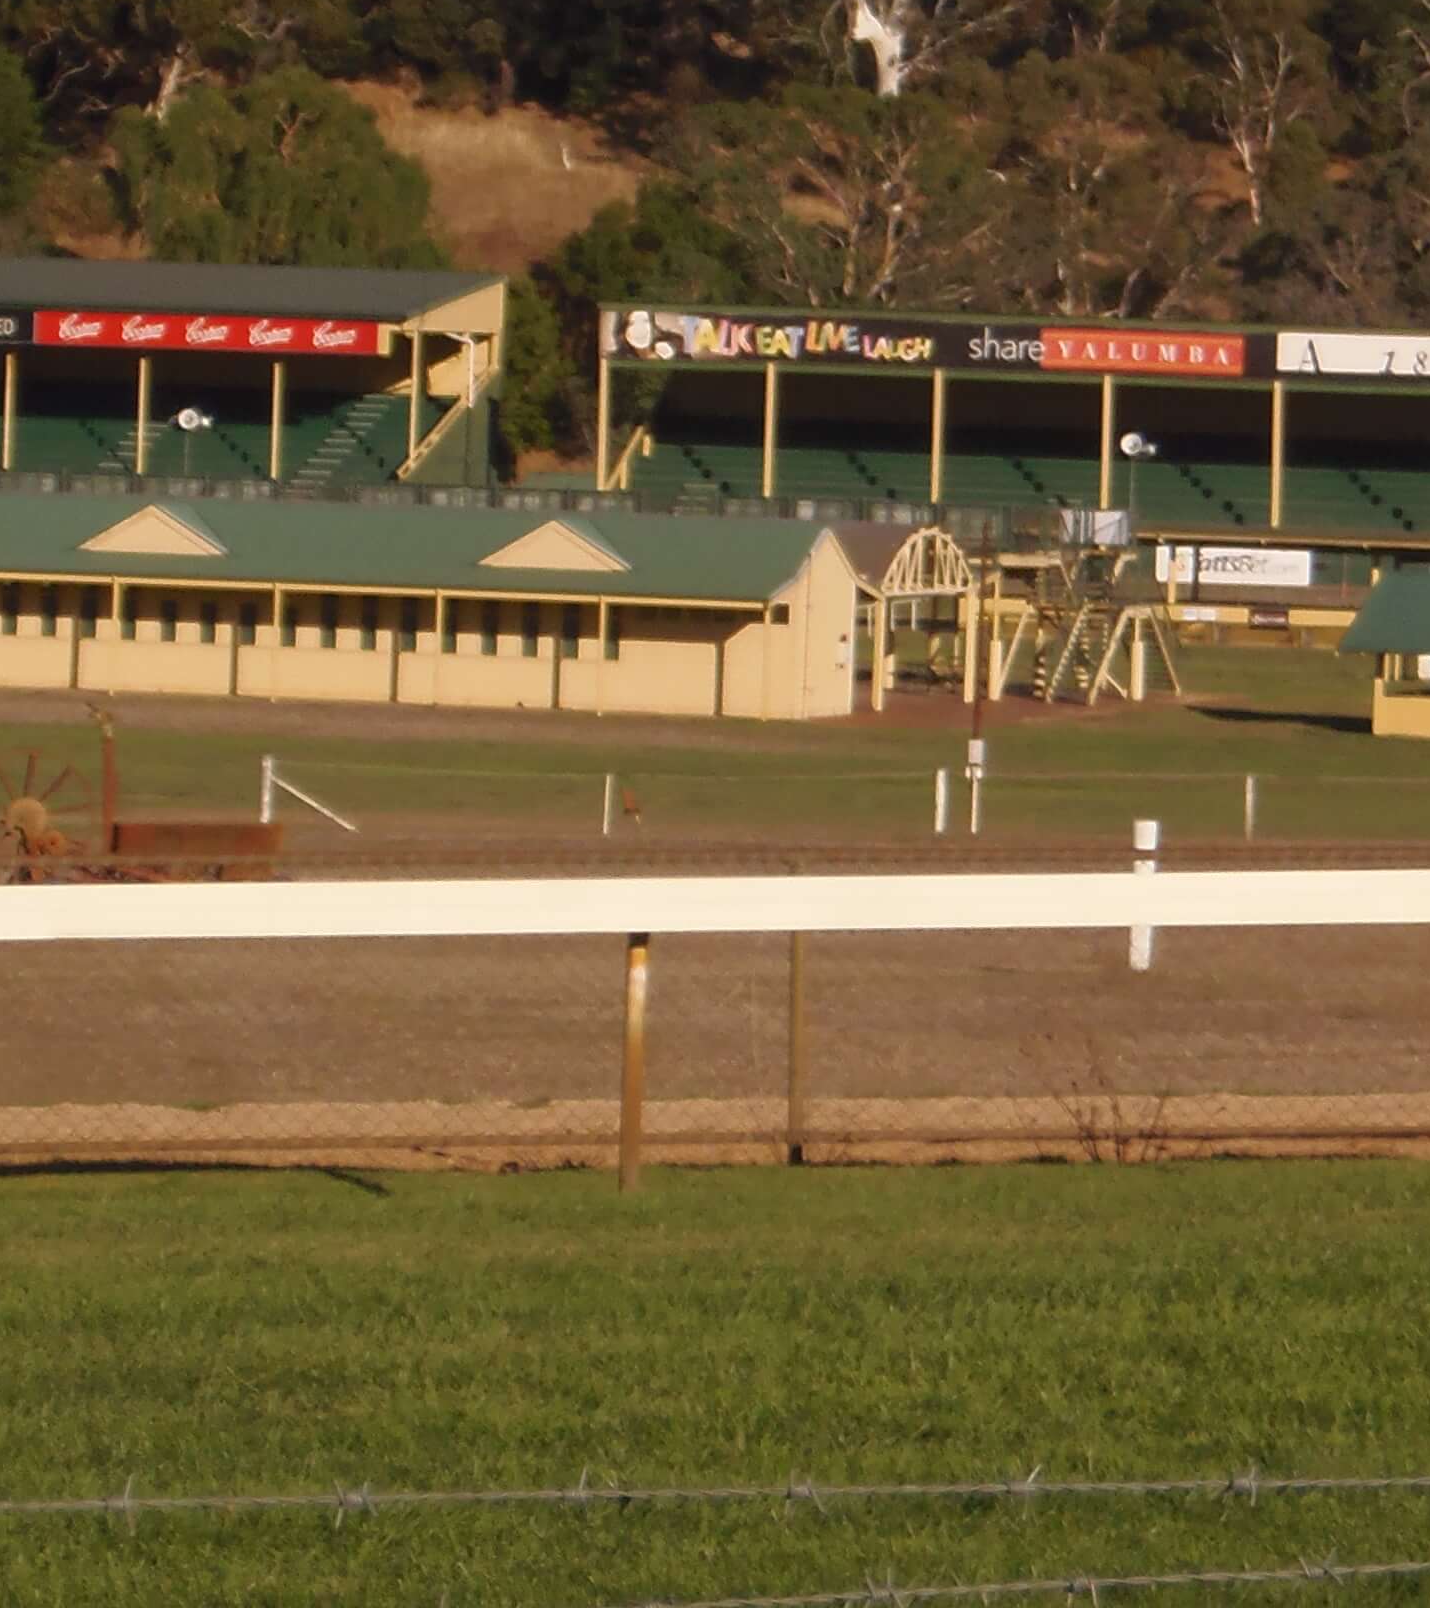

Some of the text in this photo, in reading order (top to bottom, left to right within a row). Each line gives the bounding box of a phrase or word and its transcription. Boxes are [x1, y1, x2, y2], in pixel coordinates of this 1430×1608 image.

[680, 316, 932, 361] TALK EAT LIVE LAUGH
[968, 327, 1229, 366] share YALUMBA
